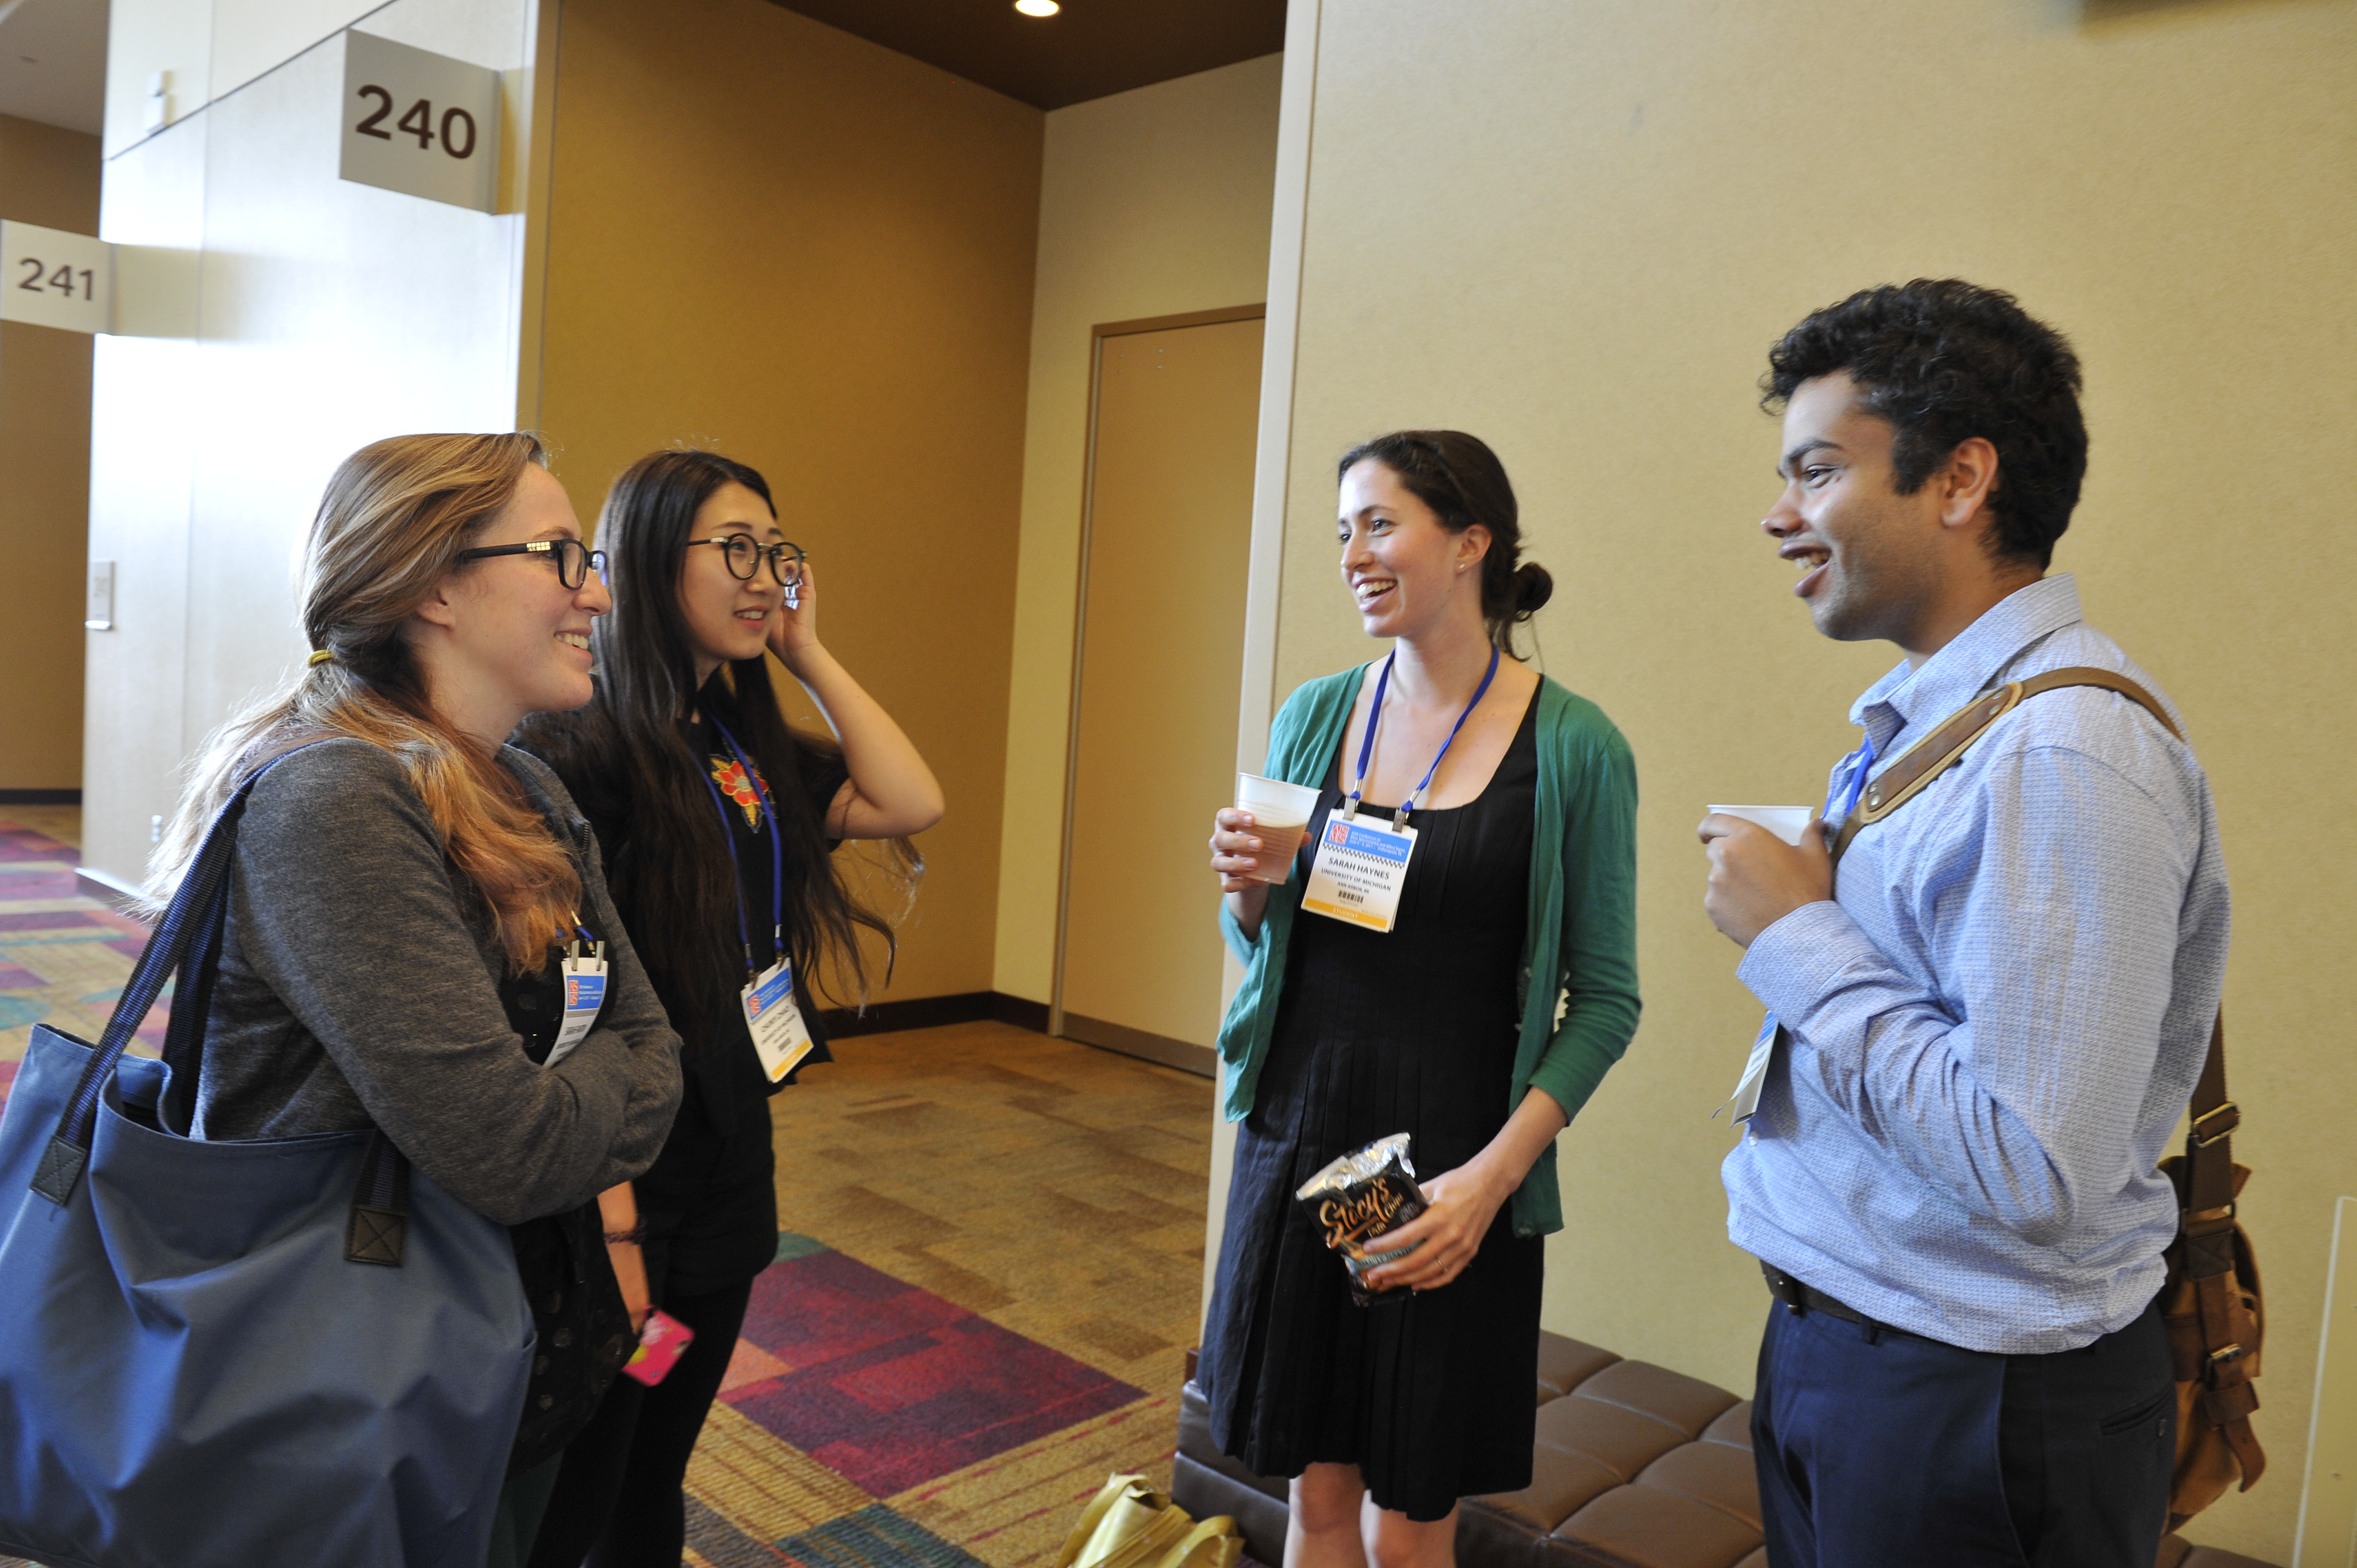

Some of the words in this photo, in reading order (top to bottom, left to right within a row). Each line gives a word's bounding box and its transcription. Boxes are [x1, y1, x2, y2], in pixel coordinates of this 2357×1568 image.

[354, 84, 477, 159] 240
[17, 257, 94, 302] 241
[1321, 867, 1353, 880] UNIVERSITY
[1362, 879, 1391, 891] MICHIGAN
[1329, 857, 1356, 871] SARAH
[1357, 864, 1390, 880] HAYNES
[1320, 1177, 1390, 1249] Stacy's
